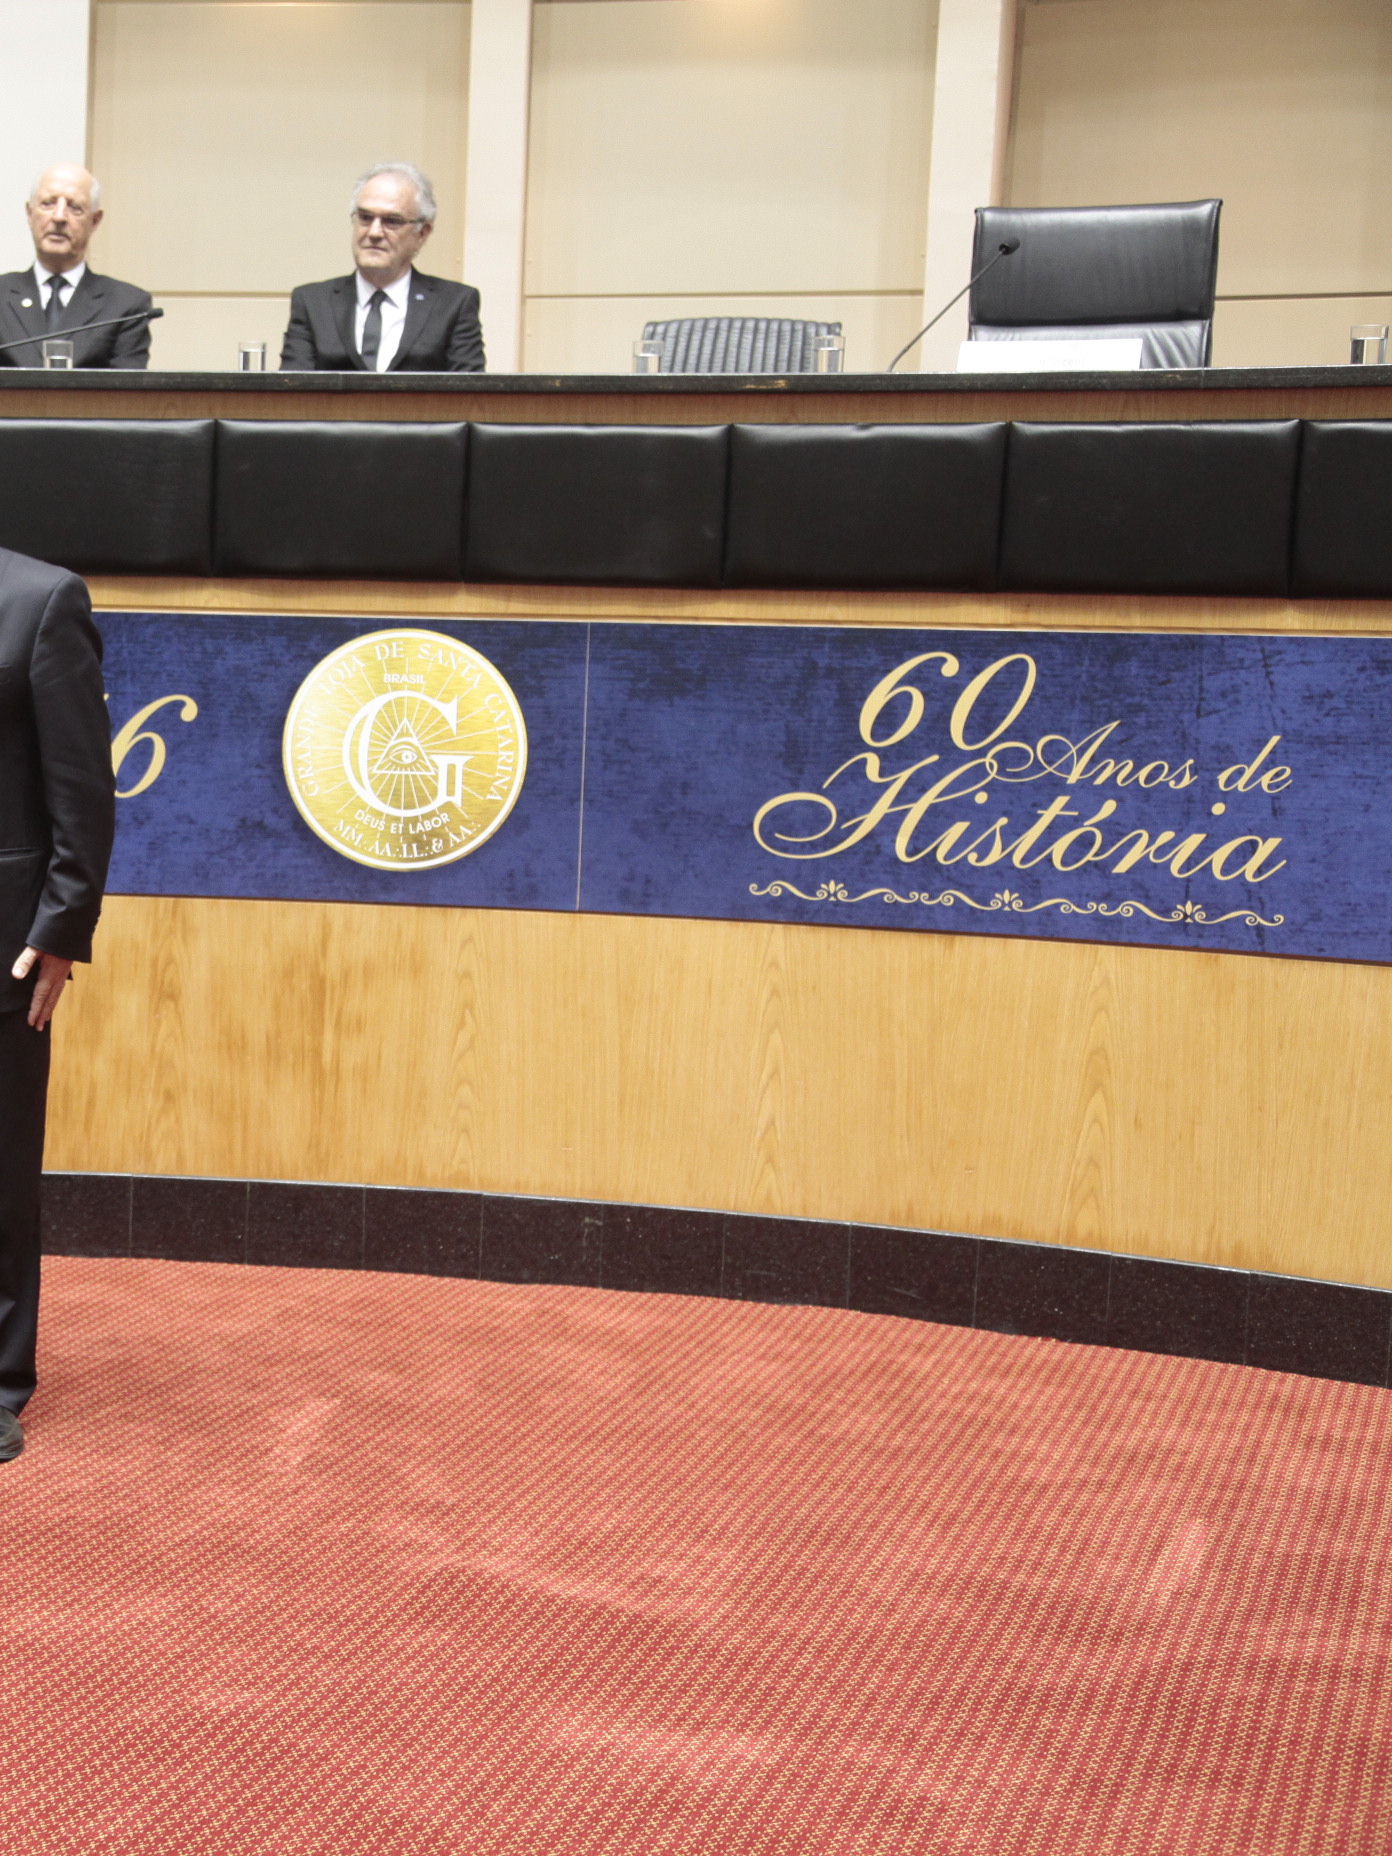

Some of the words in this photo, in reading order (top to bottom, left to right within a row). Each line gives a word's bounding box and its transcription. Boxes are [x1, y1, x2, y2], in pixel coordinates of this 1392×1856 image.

[318, 655, 366, 695] LOJA
[374, 641, 405, 661] DE
[418, 643, 482, 688] SANTA
[485, 693, 514, 801] CATARINA
[383, 673, 426, 684] BRASIL
[858, 651, 1037, 751] 60
[985, 720, 1198, 789] Anos
[1217, 735, 1294, 794] de
[342, 690, 474, 817] G
[752, 751, 1288, 883] História
[354, 809, 386, 831] DEUS
[390, 823, 404, 834] ET
[409, 813, 450, 834] LABOR
